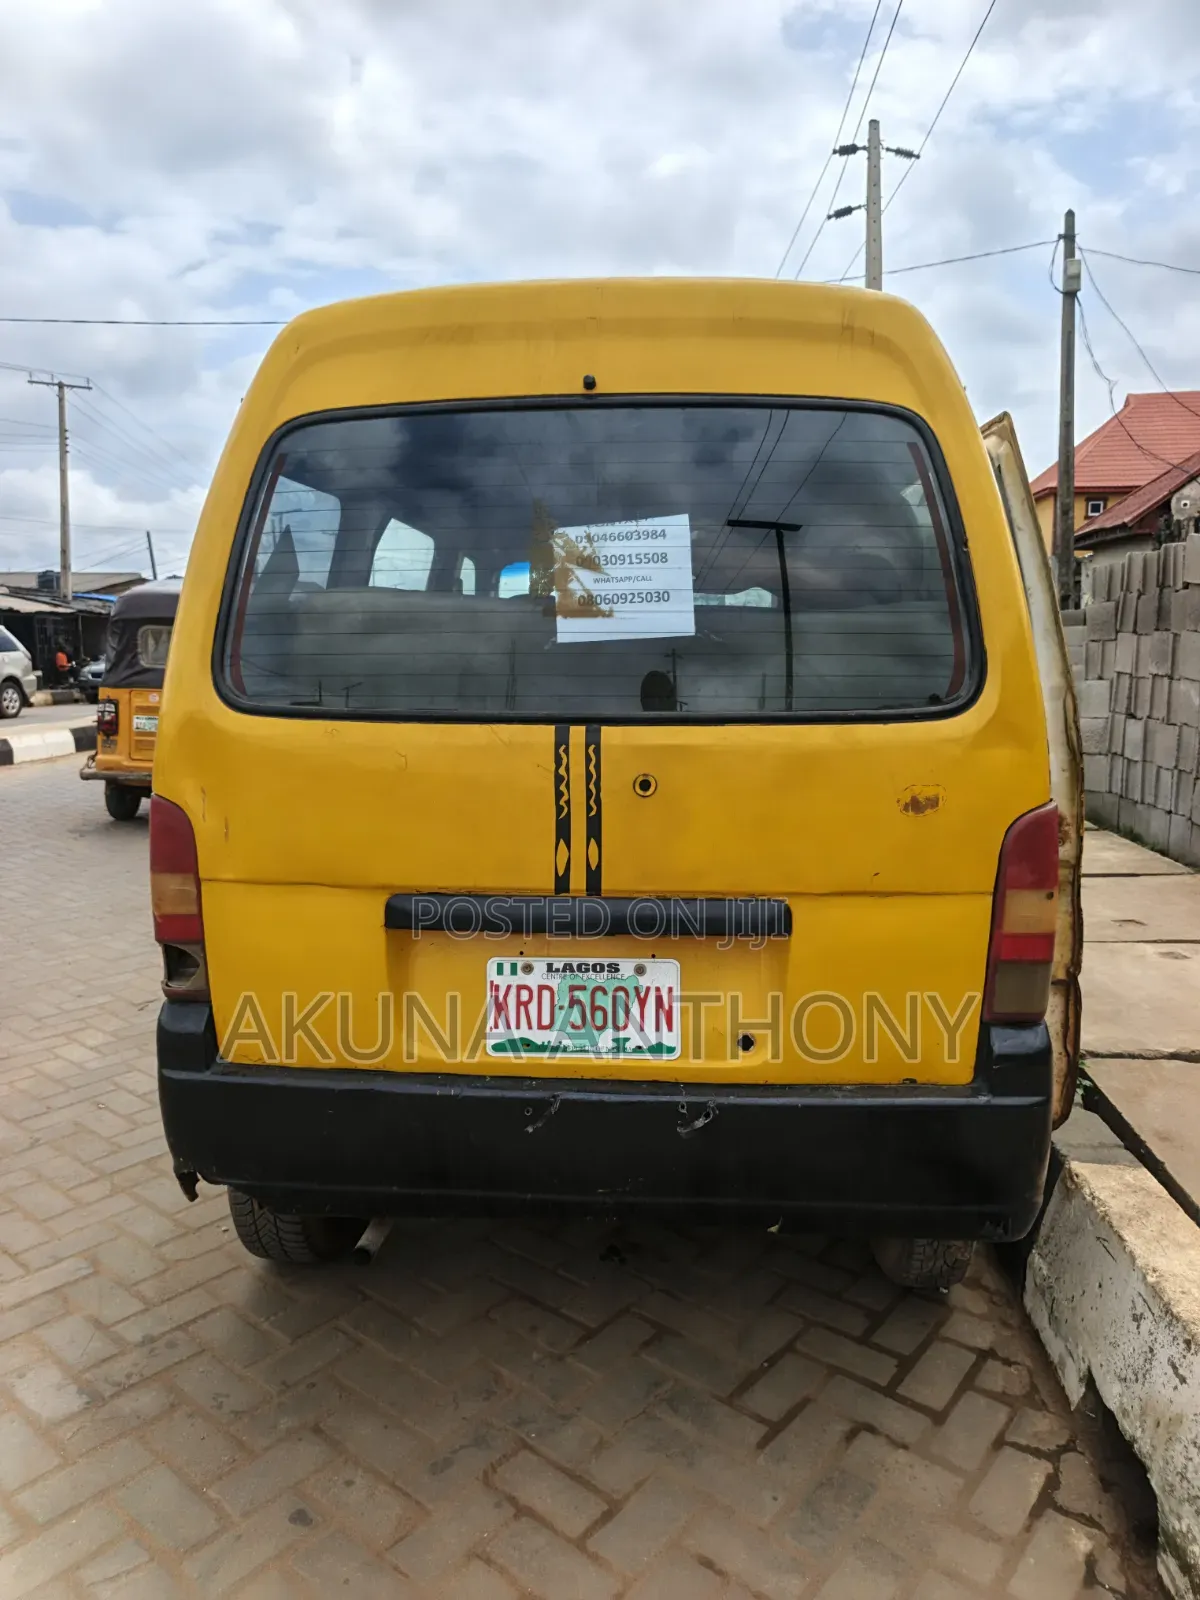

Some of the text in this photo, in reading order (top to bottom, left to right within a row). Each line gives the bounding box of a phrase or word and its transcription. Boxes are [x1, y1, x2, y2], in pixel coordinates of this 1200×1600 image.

[593, 575, 653, 584] WHATSAPP/CALL
[577, 590, 670, 607] 08060925030
[546, 962, 620, 973] LAGOS
